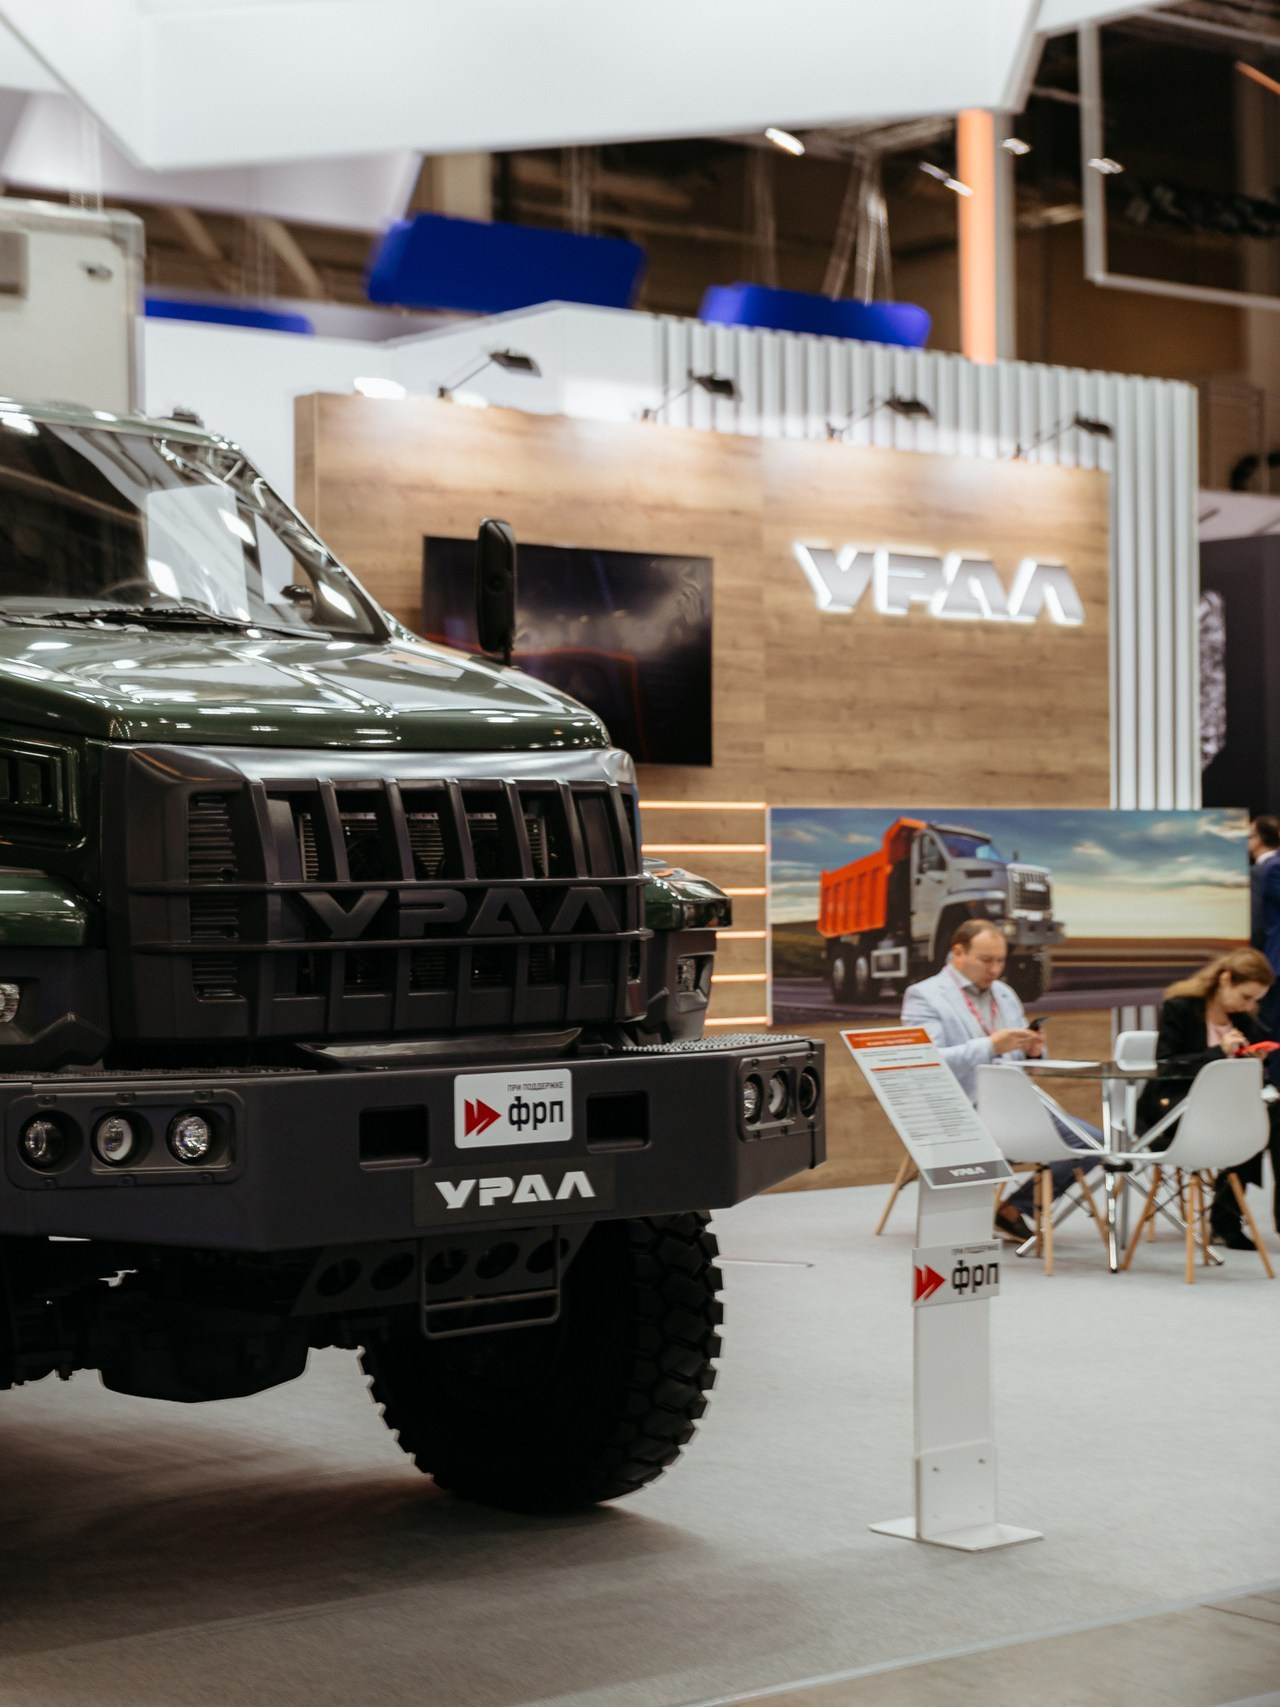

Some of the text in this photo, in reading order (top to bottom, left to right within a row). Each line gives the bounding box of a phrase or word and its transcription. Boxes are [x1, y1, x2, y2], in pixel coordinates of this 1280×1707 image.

[792, 543, 1086, 626] УРАЛ
[300, 886, 619, 940] УРАЛ
[507, 1081, 564, 1092] ПРИ ПОДДЕРЖКЕ
[508, 1096, 564, 1132] фрп
[434, 1170, 597, 1210] УРАЛ
[951, 1260, 999, 1295] фрп
